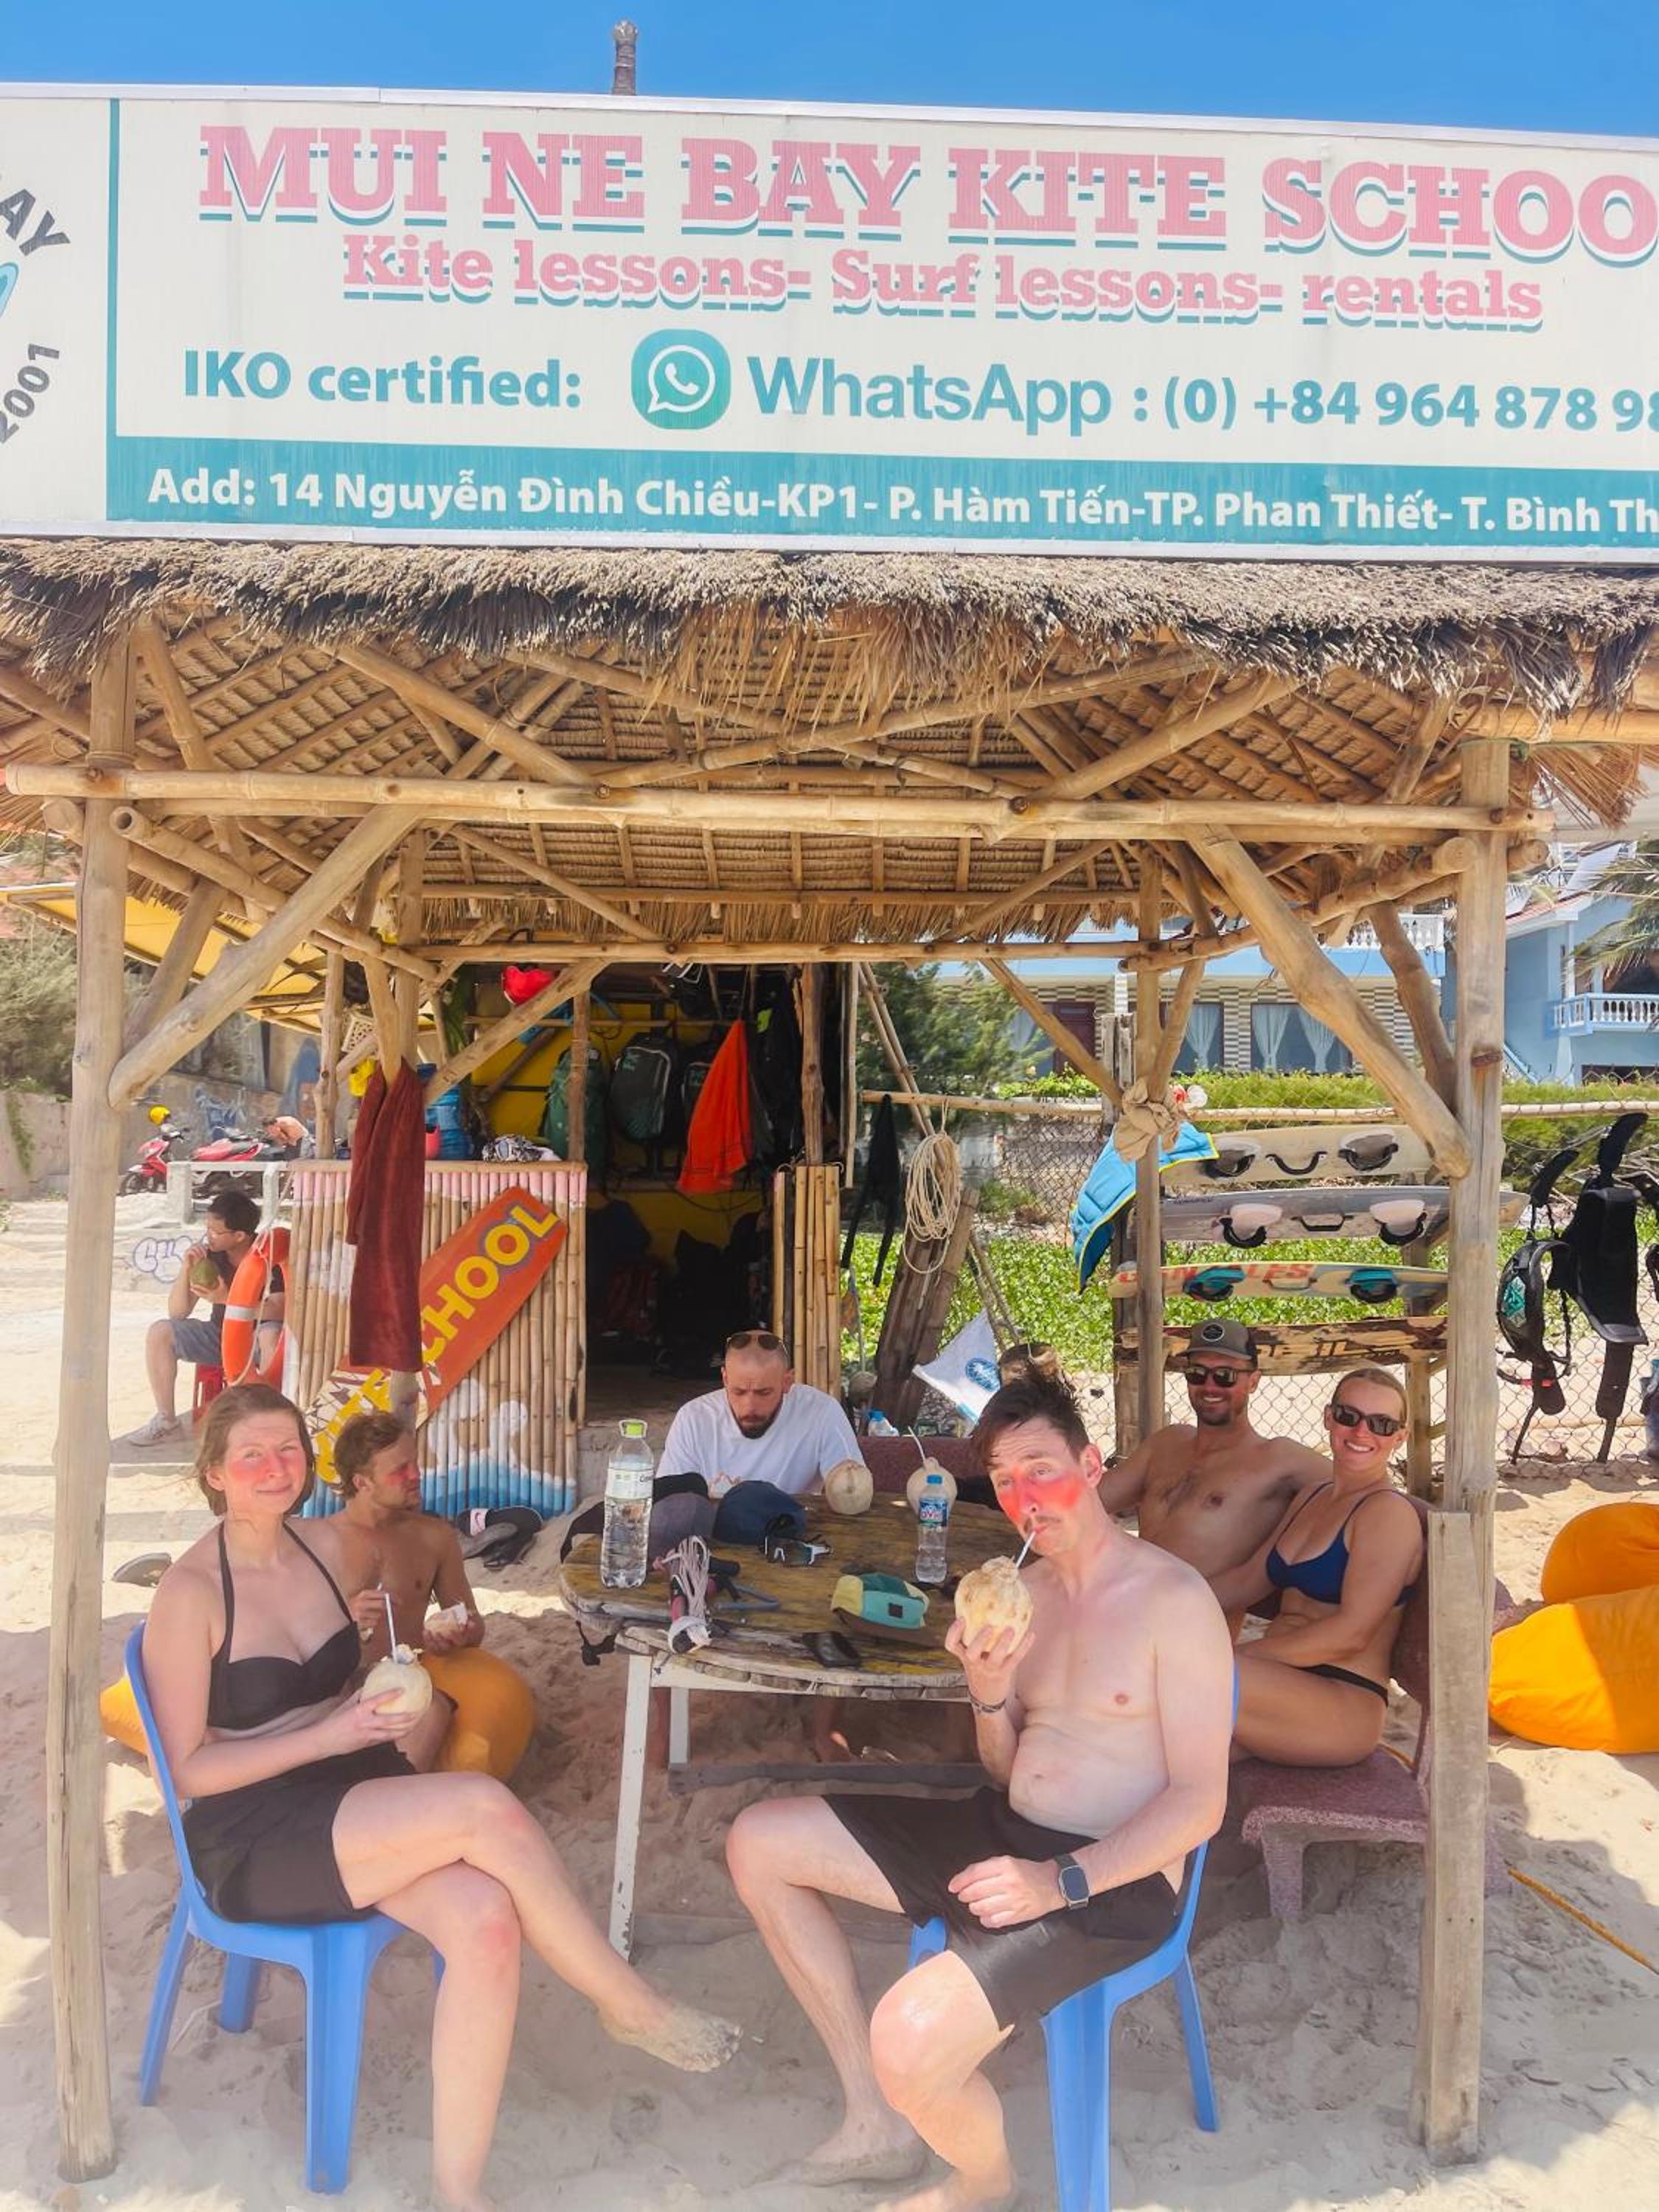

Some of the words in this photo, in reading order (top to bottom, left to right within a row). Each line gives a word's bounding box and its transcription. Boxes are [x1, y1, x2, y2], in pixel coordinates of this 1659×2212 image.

[0, 187, 72, 257] AY
[198, 125, 448, 226] MUI
[481, 131, 644, 233] NE
[681, 138, 921, 241] BAY
[948, 147, 1228, 251] KITE
[1262, 159, 1658, 268] SCHOO
[344, 234, 493, 305] Kite
[513, 240, 811, 313] lessons-
[831, 249, 980, 319] Surf
[995, 255, 1283, 324] lessons-
[1302, 269, 1544, 333] rentals
[185, 351, 291, 399] IKO
[307, 355, 580, 408] certified:
[747, 357, 1111, 437] WhatsApp
[1164, 377, 1237, 430] (0)
[1254, 380, 1360, 425] +84
[1375, 383, 1479, 427] 964
[1495, 386, 1597, 431] 878
[147, 468, 255, 506] Add:
[269, 473, 322, 507] 14
[335, 469, 507, 521] Nguyễn
[518, 476, 623, 514] Đình
[890, 486, 922, 520] P.
[934, 487, 1030, 523] Hàm
[1039, 484, 1204, 526] Tiến-TP.
[1215, 493, 1321, 527] Phan
[1330, 490, 1453, 529] Thiết-
[1461, 496, 1495, 530] T.
[1507, 498, 1600, 532] Bình
